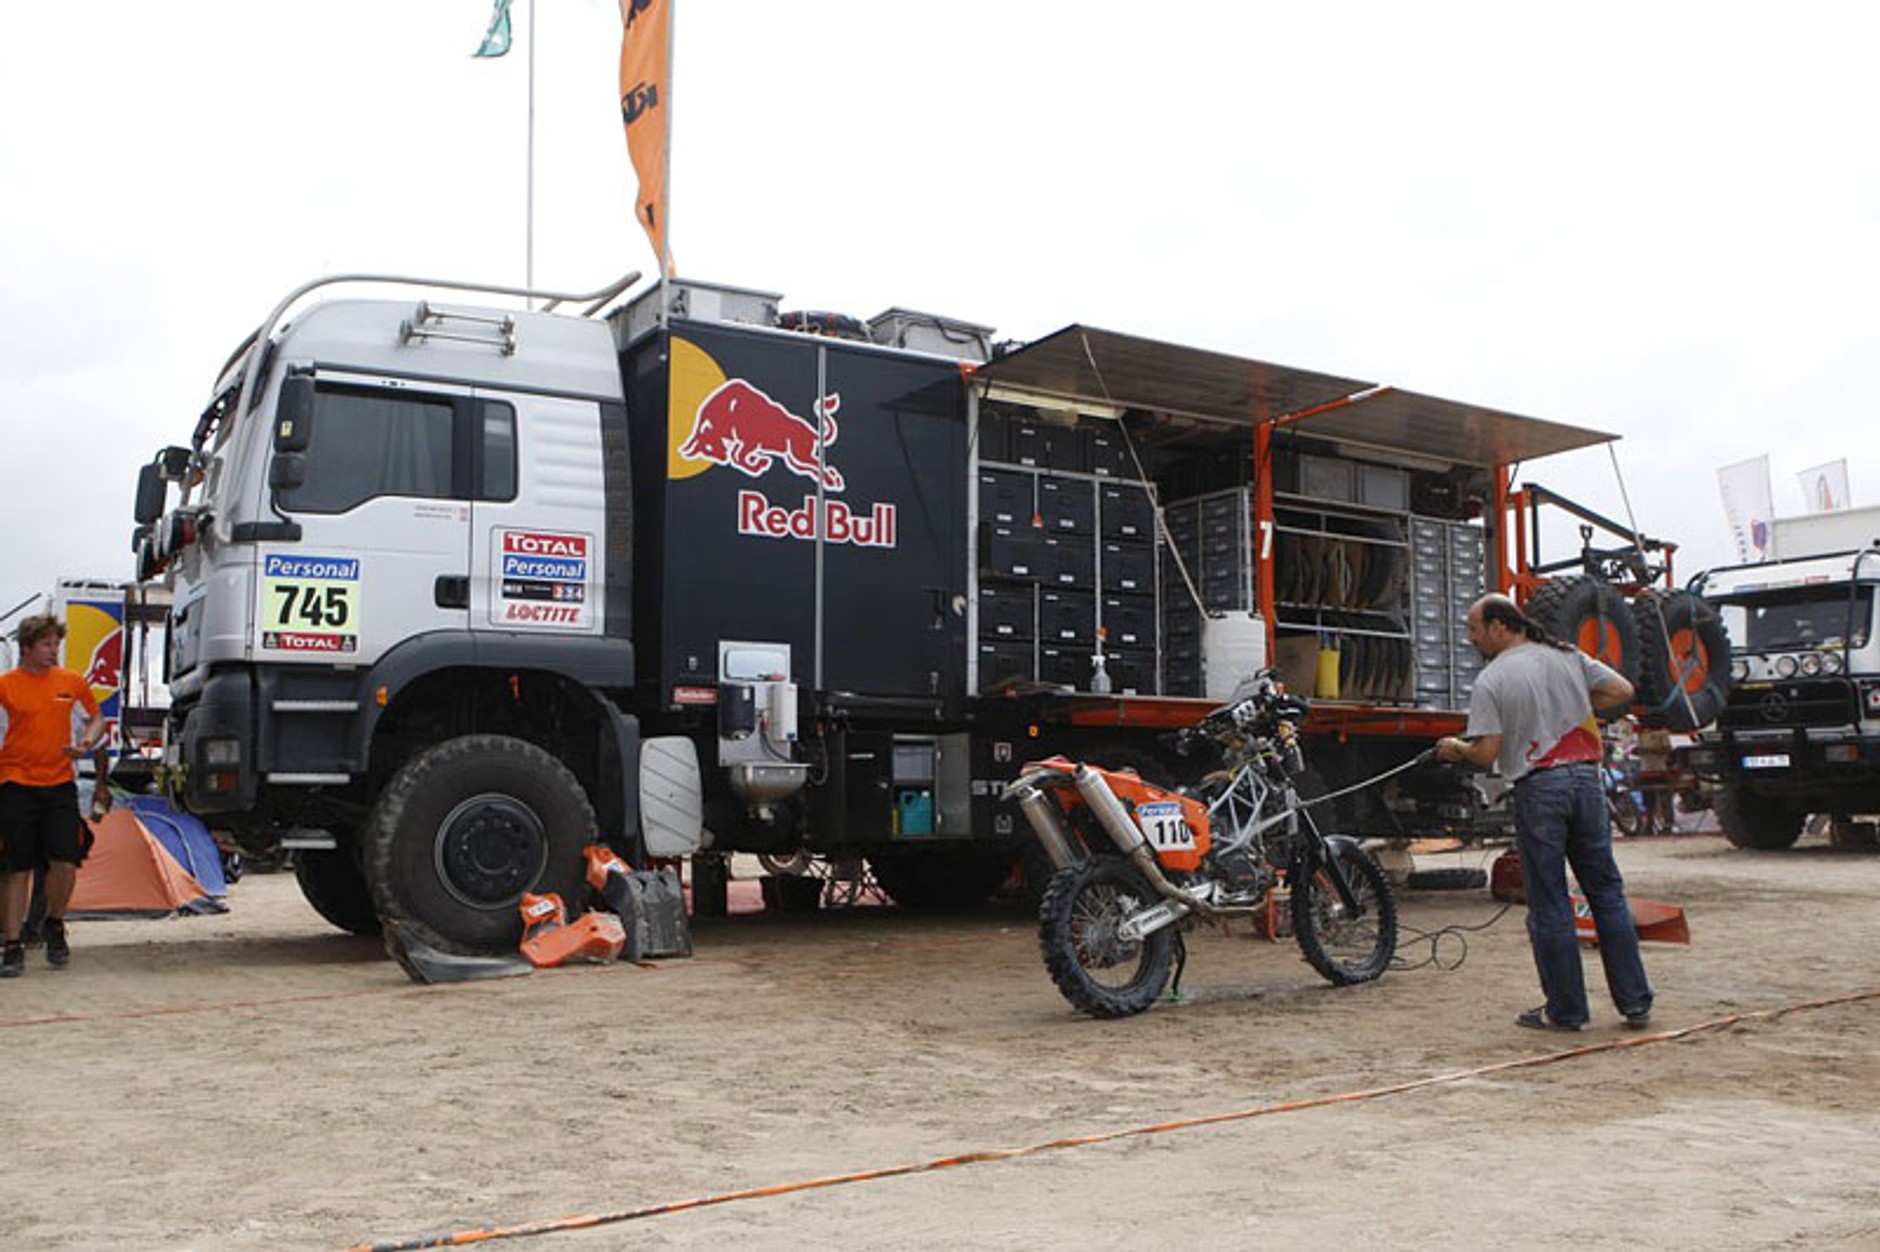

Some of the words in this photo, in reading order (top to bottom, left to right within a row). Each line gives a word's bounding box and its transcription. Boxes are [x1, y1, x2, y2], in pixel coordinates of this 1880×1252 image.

[738, 490, 817, 541] Red
[825, 501, 897, 548] Bull
[267, 557, 357, 578] Personal
[505, 558, 584, 578] Personal
[275, 585, 348, 626] 745
[506, 603, 581, 622] LOCTITE
[1155, 819, 1190, 844] 110
